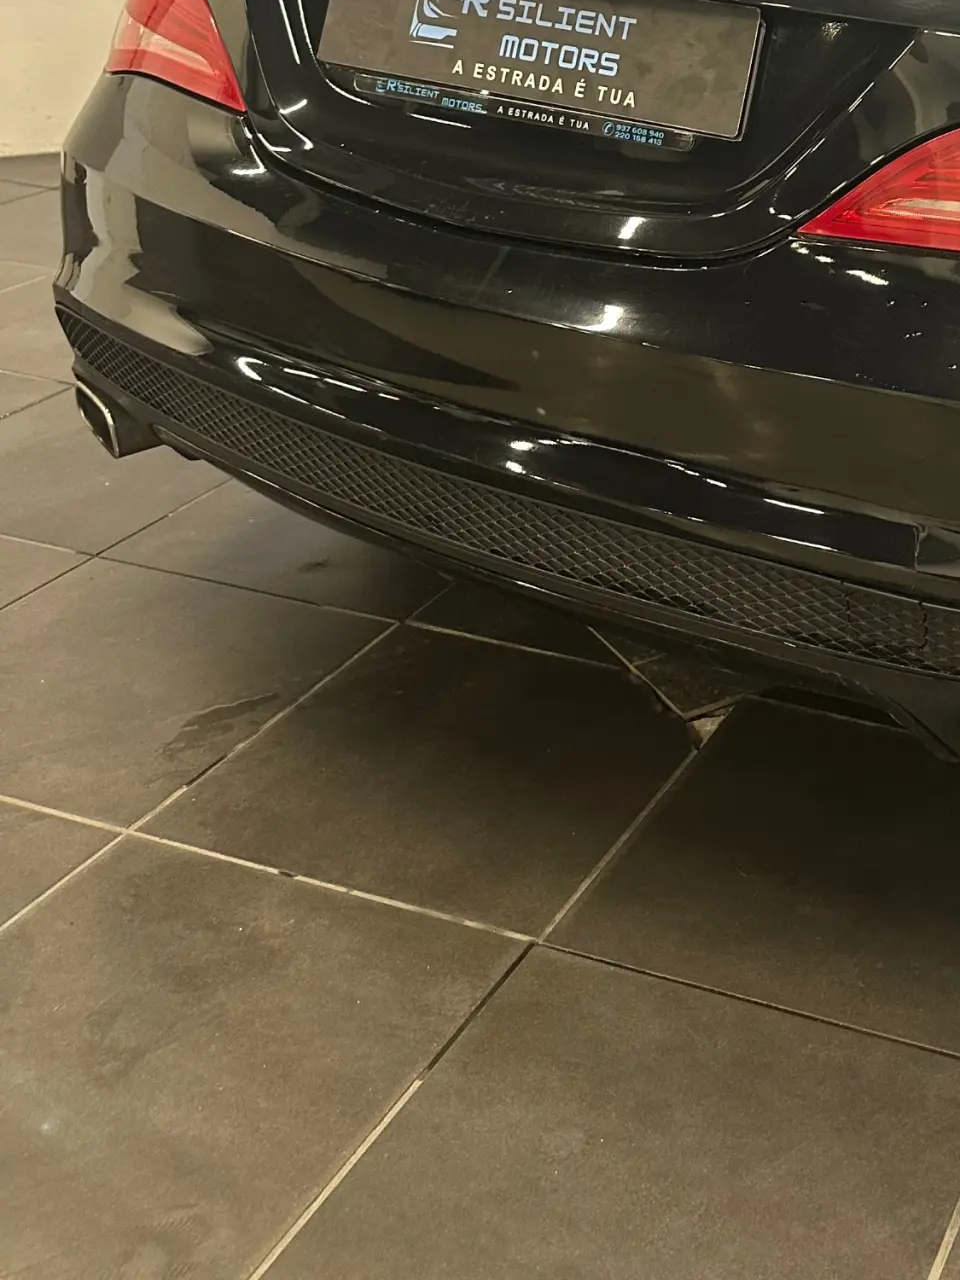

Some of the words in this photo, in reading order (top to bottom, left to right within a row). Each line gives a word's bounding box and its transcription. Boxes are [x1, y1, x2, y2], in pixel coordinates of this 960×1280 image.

[499, 34, 621, 77] MOTORS
[452, 59, 463, 75] A
[473, 63, 563, 94] ESTRADA
[574, 79, 586, 98] É
[597, 85, 636, 108] TUA
[441, 97, 483, 112] MOTORS
[497, 106, 503, 114] A
[508, 107, 554, 123] ESTRADA
[570, 119, 589, 130] TUA
